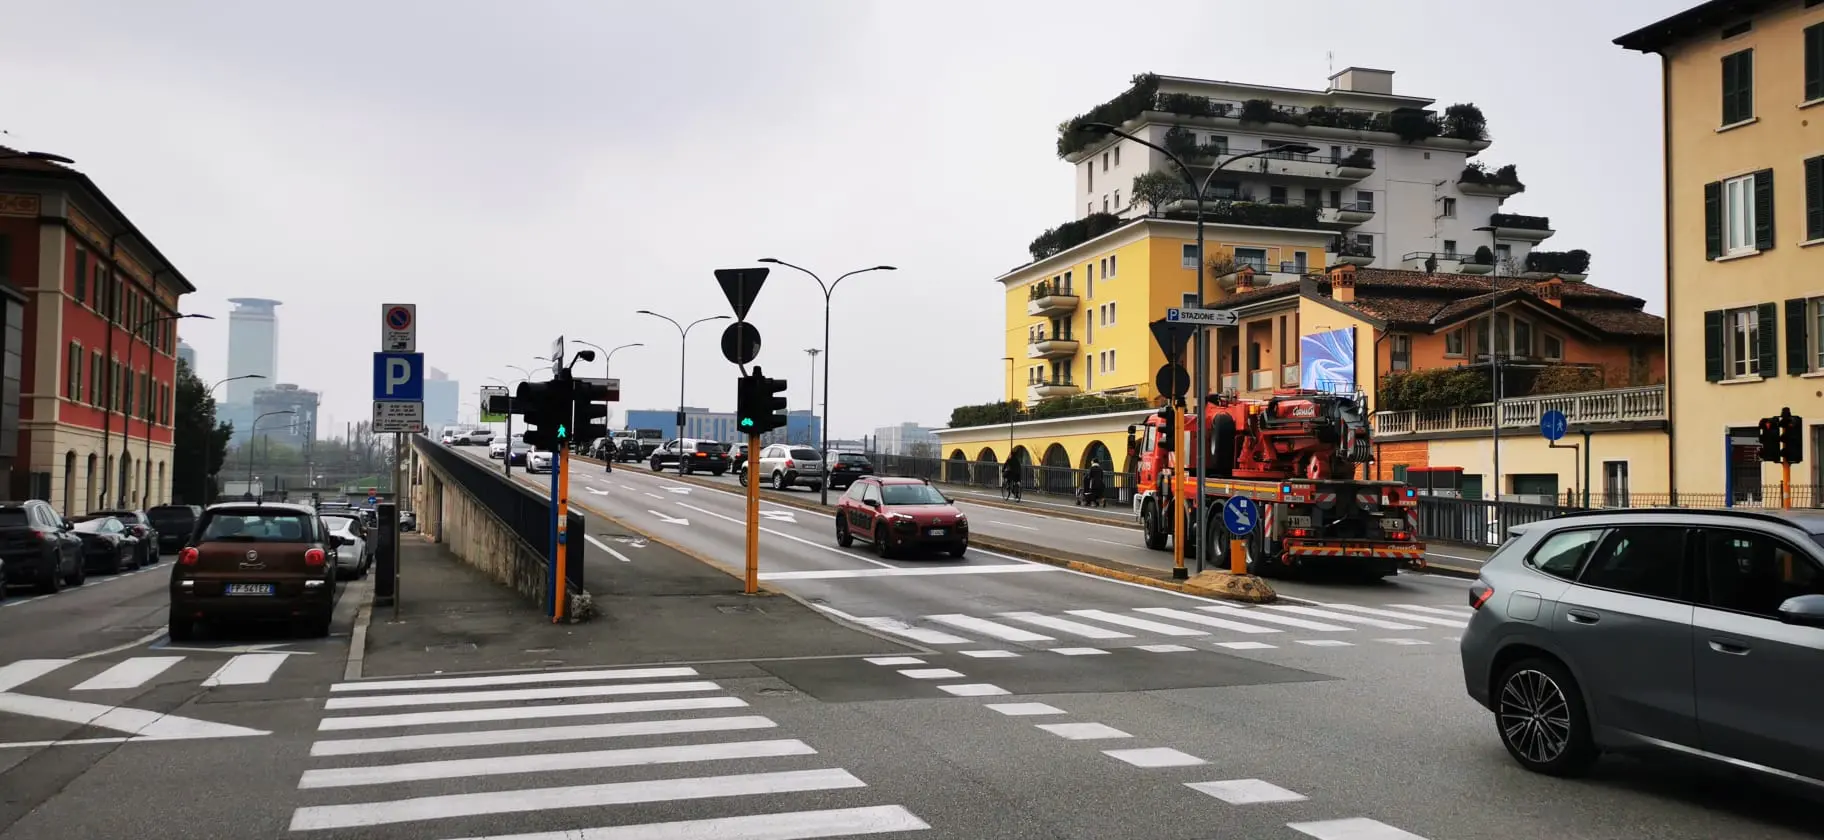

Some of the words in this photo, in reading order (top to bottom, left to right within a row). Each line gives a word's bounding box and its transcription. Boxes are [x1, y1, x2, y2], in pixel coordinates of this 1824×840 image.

[1170, 309, 1178, 320] P
[1181, 311, 1214, 321] STAZIONE
[386, 357, 411, 395] P
